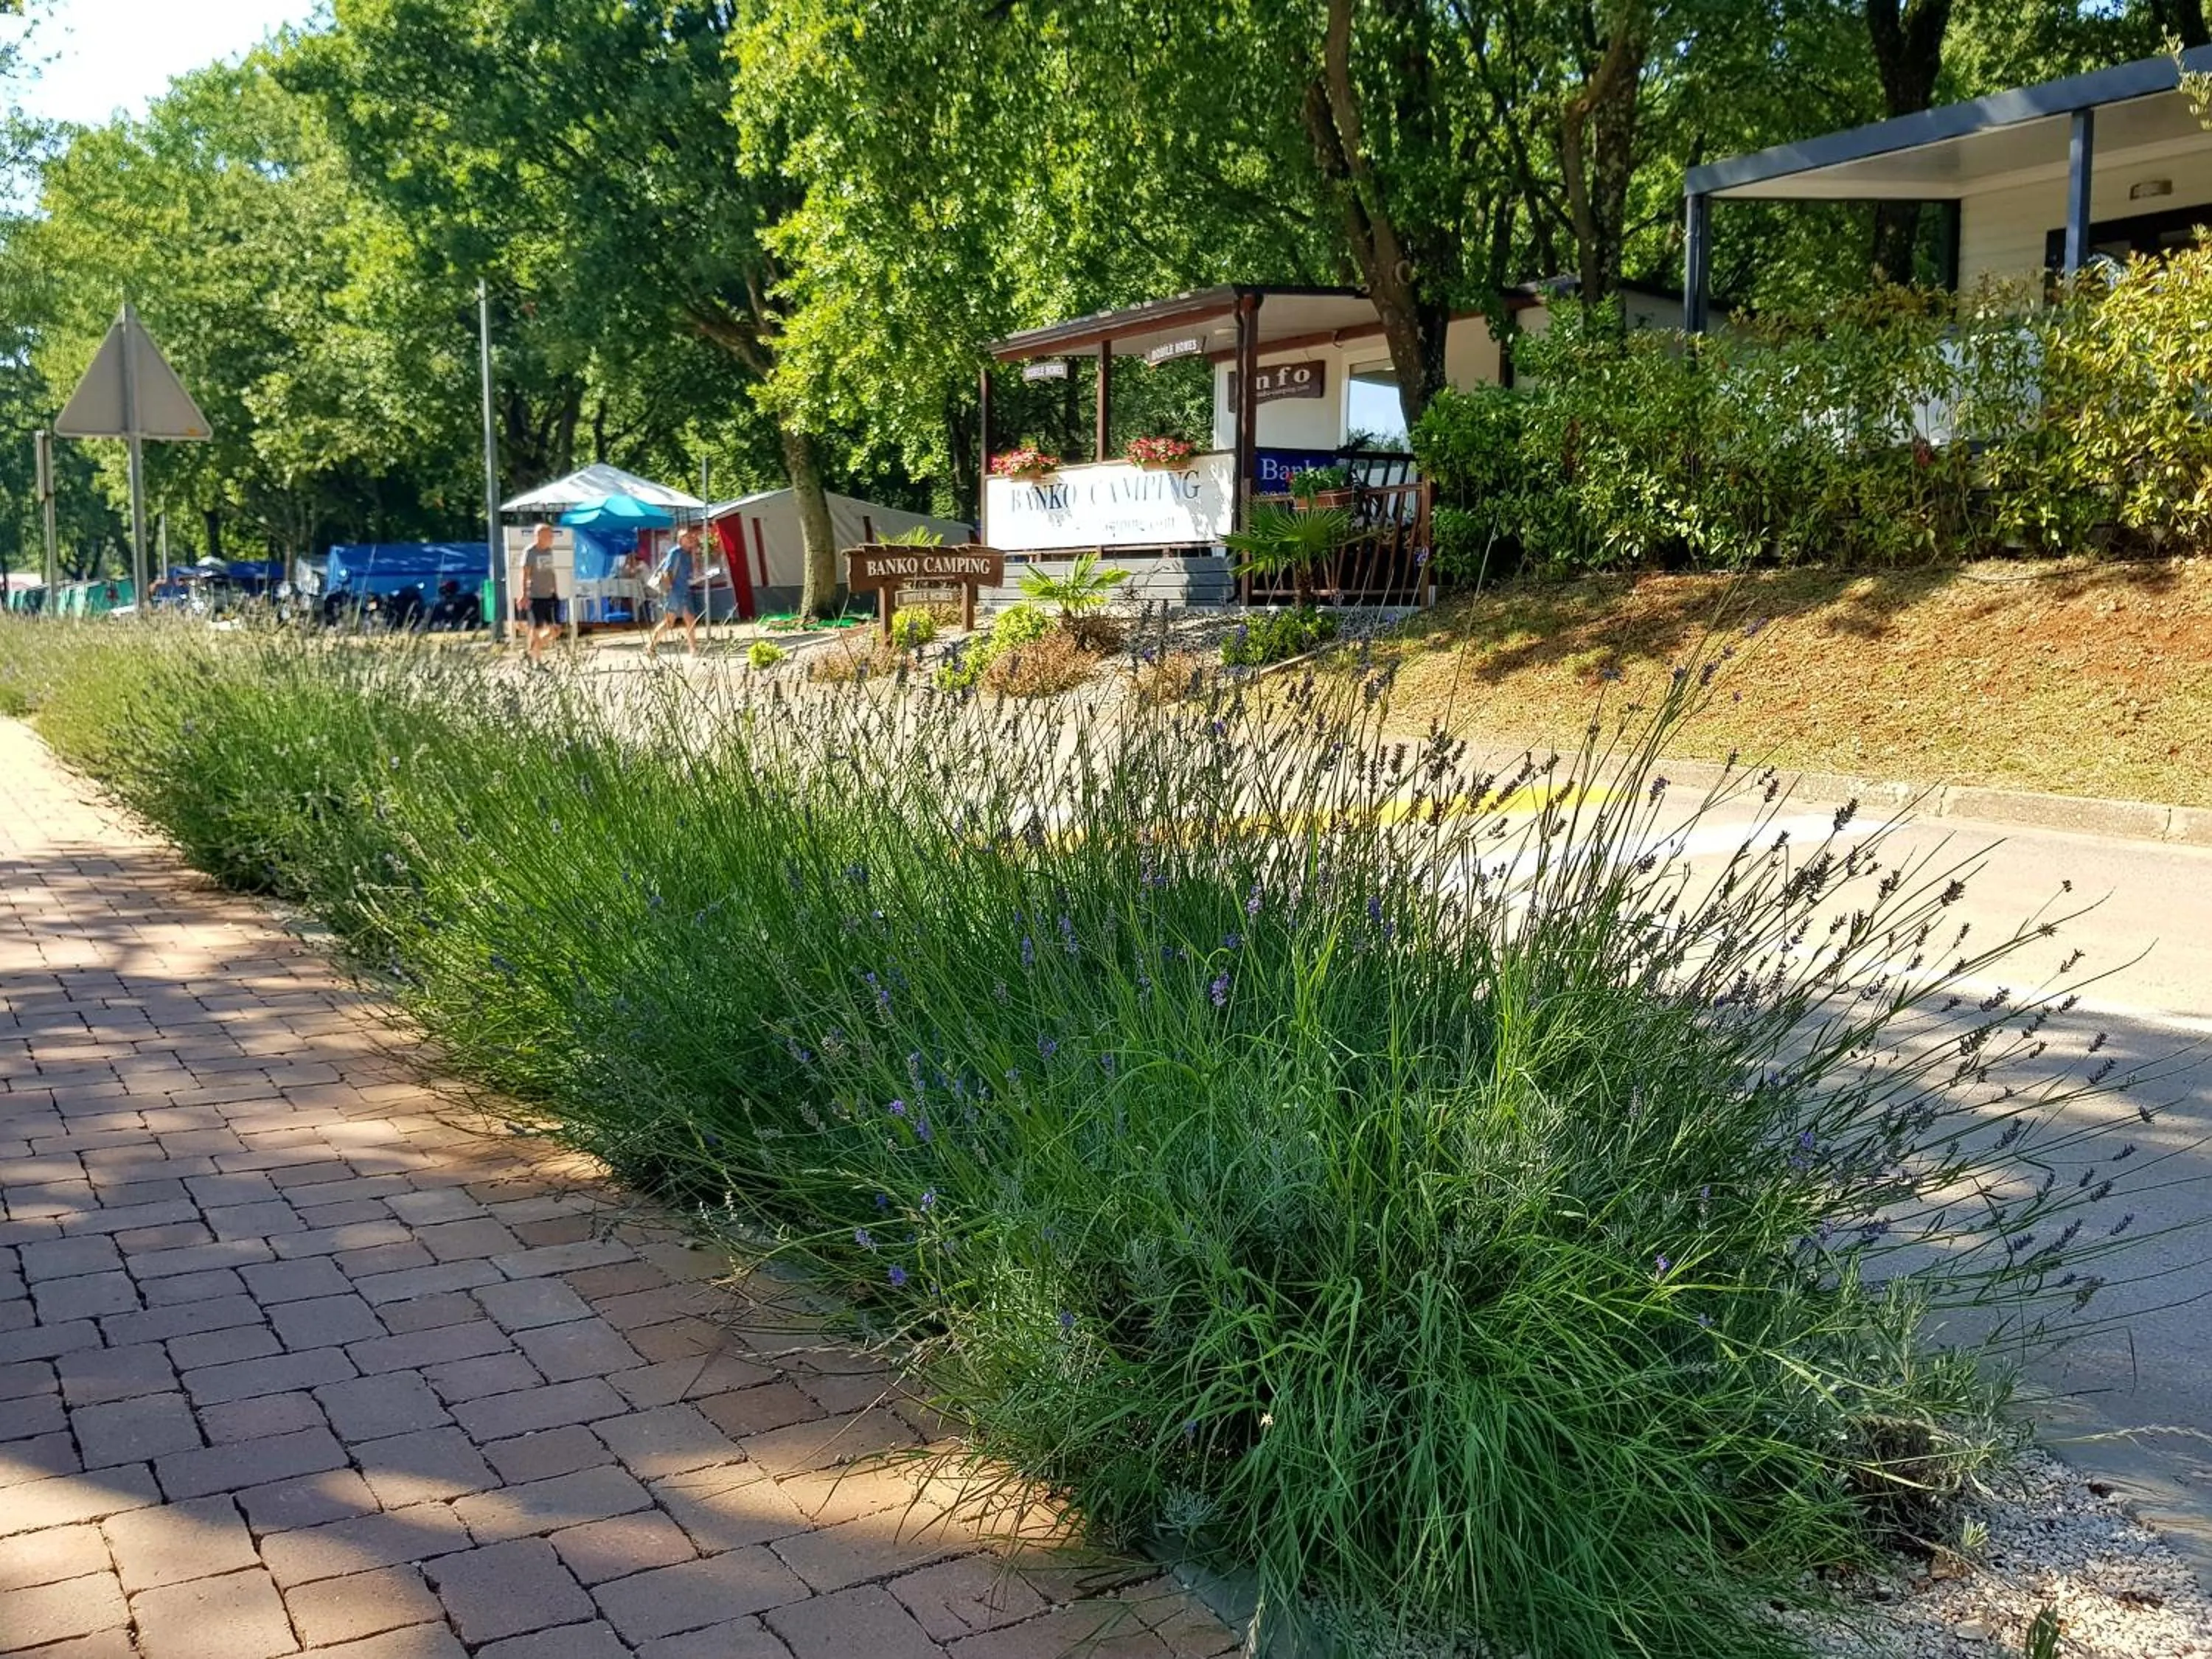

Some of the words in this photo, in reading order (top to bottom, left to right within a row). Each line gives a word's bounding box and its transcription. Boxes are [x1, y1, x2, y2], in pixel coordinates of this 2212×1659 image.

[1256, 366, 1310, 390] nfo
[1011, 482, 1077, 512] BANKO
[866, 557, 918, 577] BANKO
[923, 556, 991, 574] CAMPING
